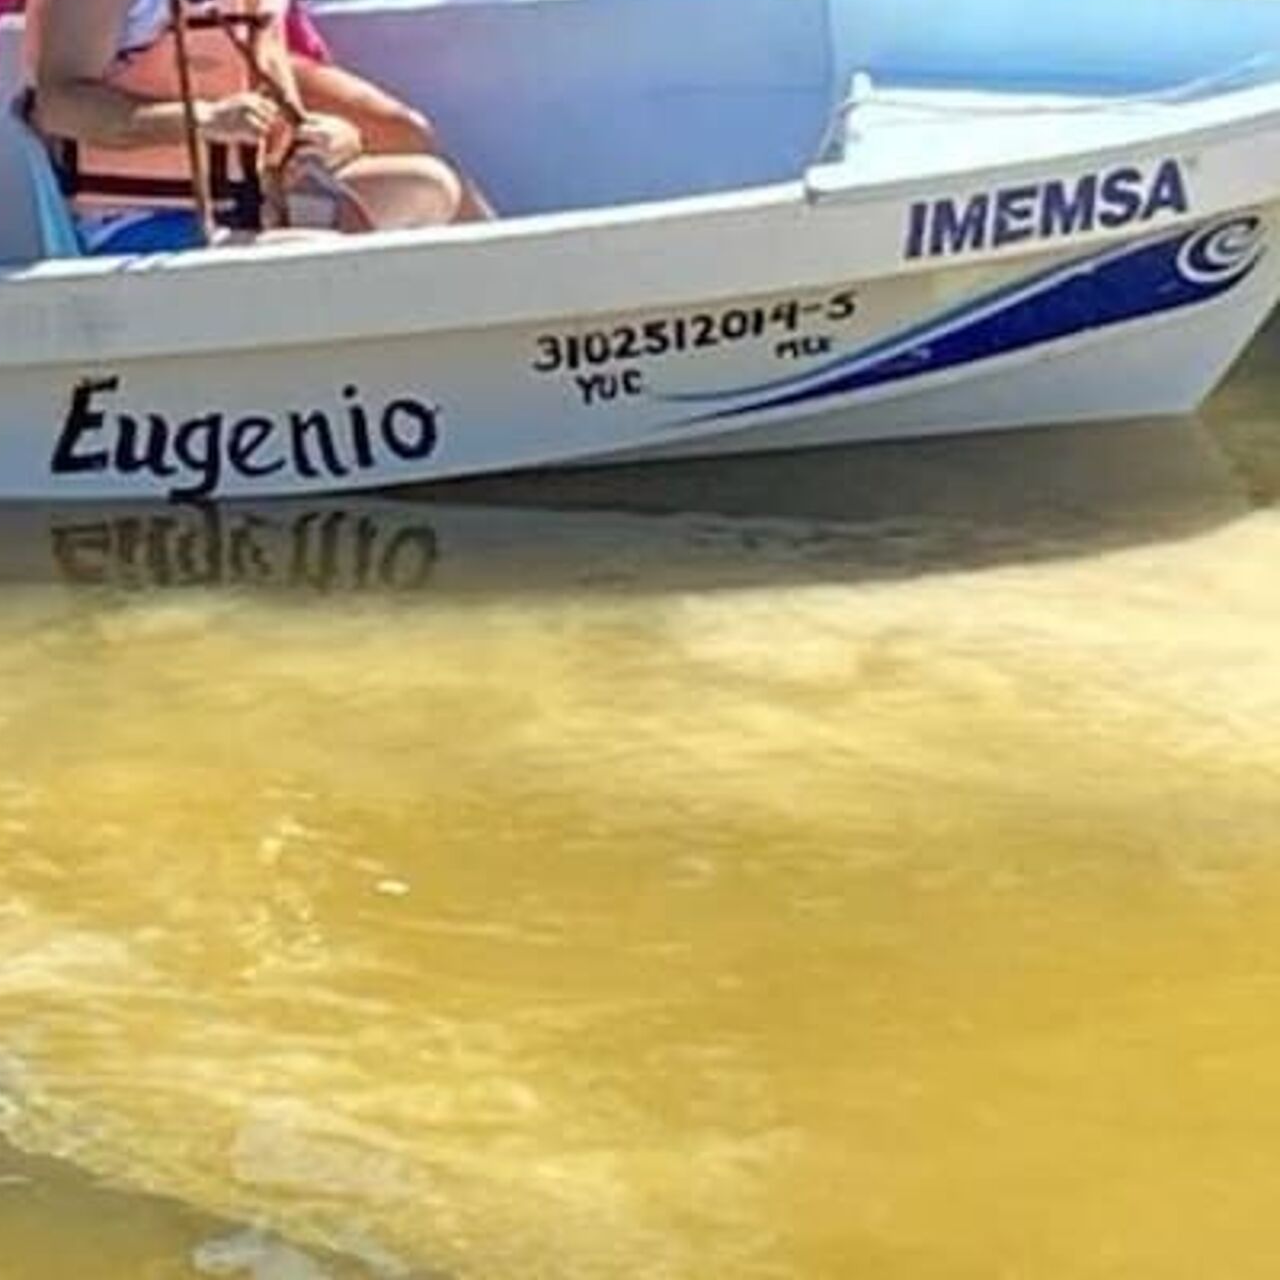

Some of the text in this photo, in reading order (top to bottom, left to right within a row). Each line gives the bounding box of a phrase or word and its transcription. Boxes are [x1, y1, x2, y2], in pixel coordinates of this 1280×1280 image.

[903, 158, 1188, 260] IMEMSA
[50, 374, 440, 502] Eugenio
[574, 369, 643, 406] YUC
